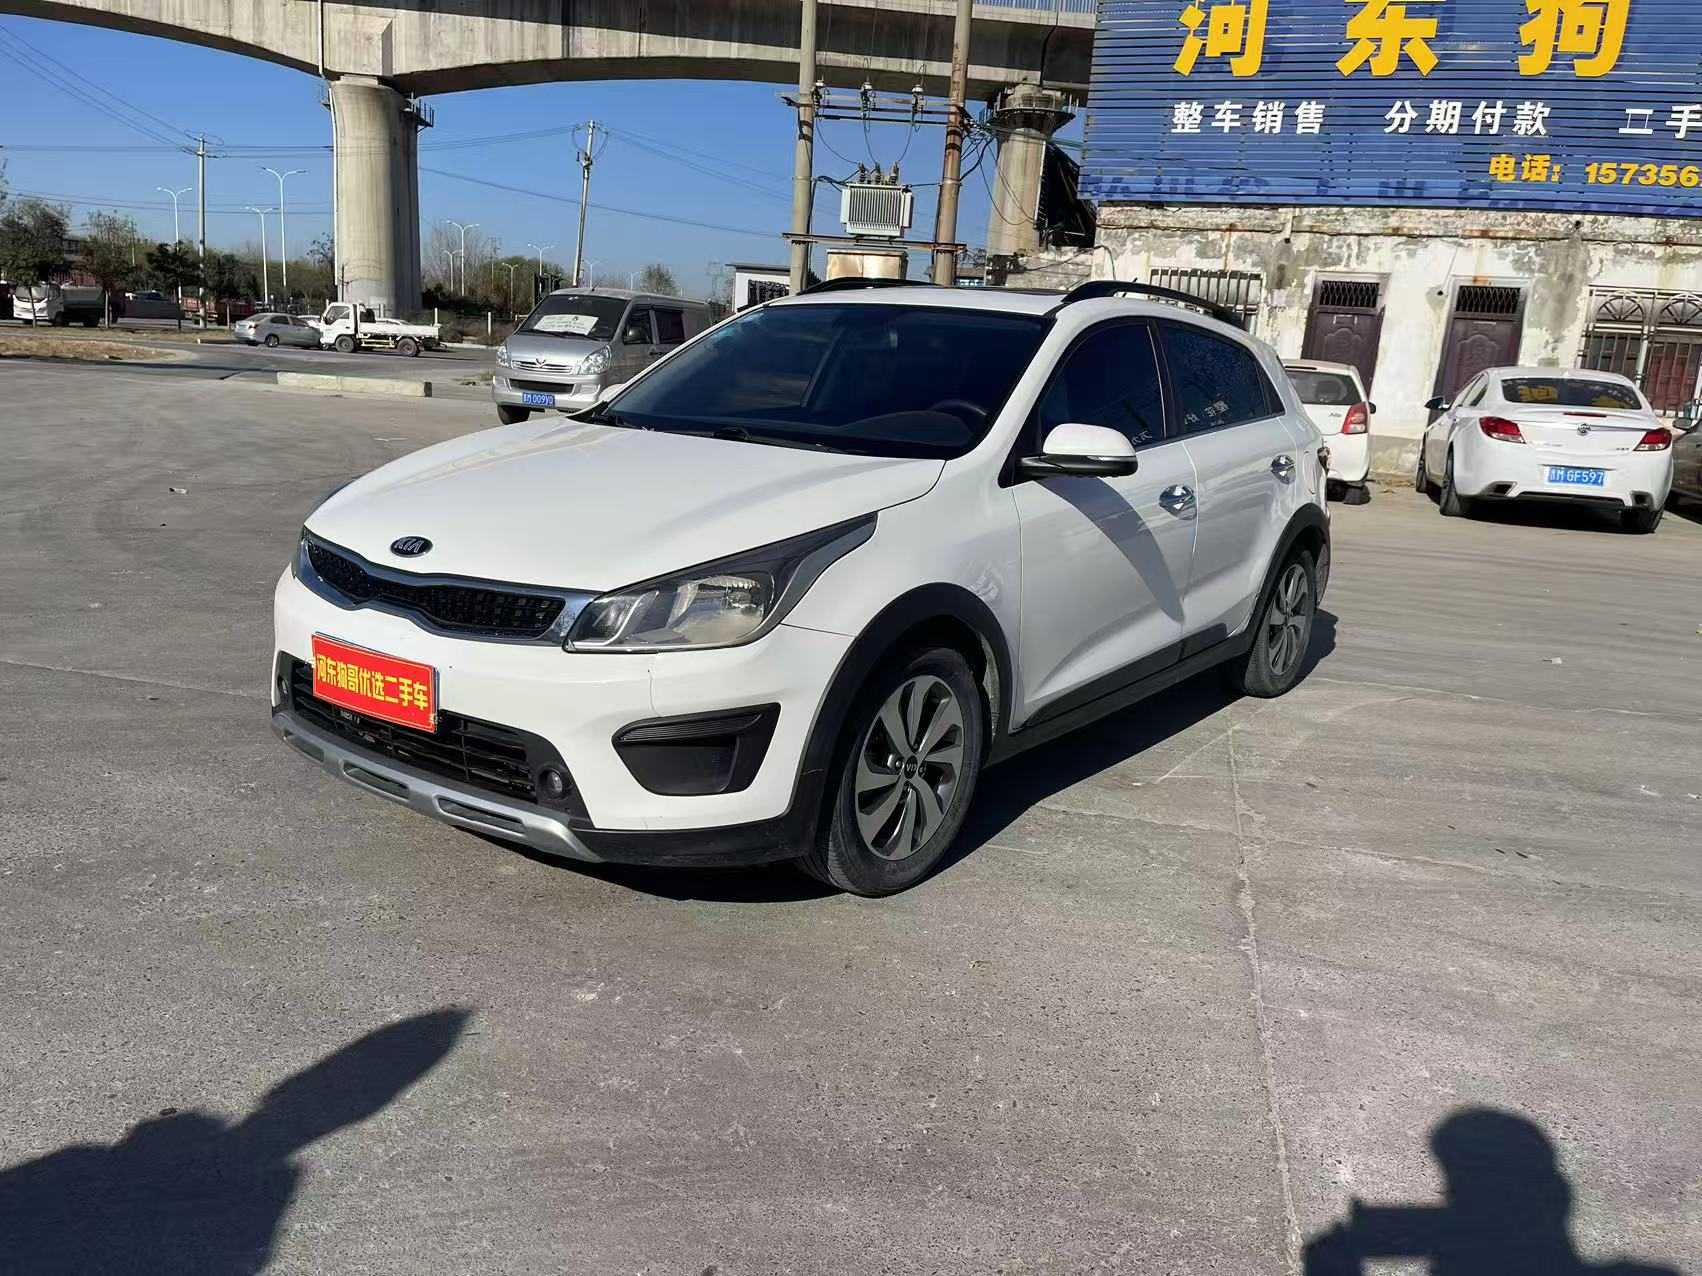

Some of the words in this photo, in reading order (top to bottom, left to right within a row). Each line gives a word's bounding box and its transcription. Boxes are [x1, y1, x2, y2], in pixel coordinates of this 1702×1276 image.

[1170, 101, 1326, 135] 整车销售
[1383, 100, 1551, 137] 分期付款
[1618, 103, 1702, 139] 二手
[393, 536, 425, 554] KIA
